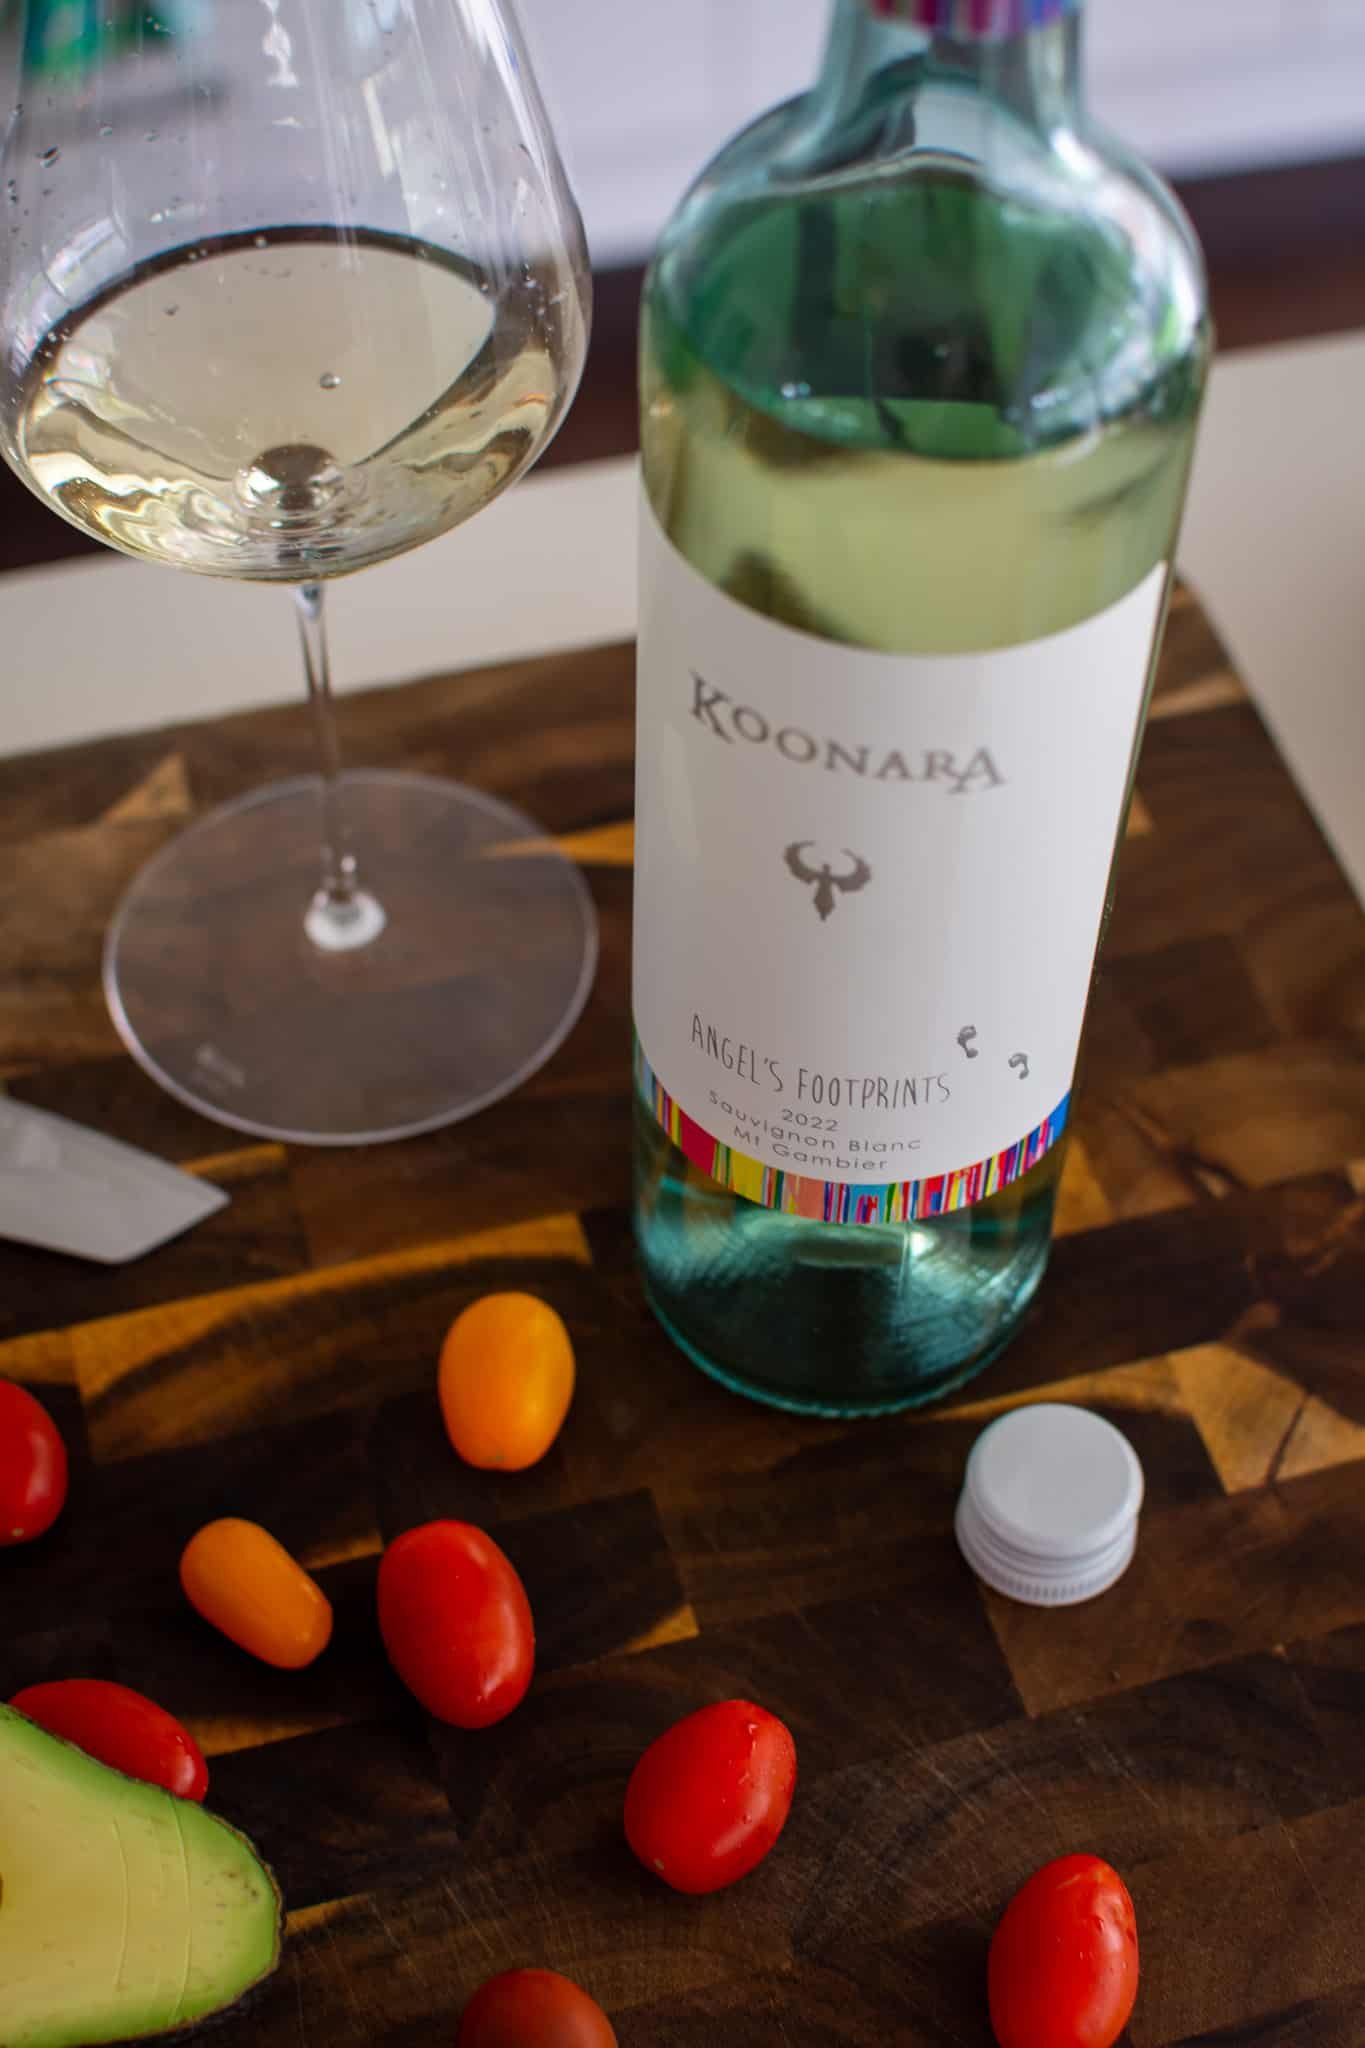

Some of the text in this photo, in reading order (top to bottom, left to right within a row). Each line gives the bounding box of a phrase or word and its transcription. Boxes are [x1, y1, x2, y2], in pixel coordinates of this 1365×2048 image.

[688, 667, 1005, 794] KOONARA
[691, 1013, 951, 1109] ANGEL'S FOOTPRINTS
[709, 1090, 921, 1153] Sauvignon Blanc
[733, 1125, 888, 1170] Mt Gambier
[781, 1108, 839, 1132] 2022
